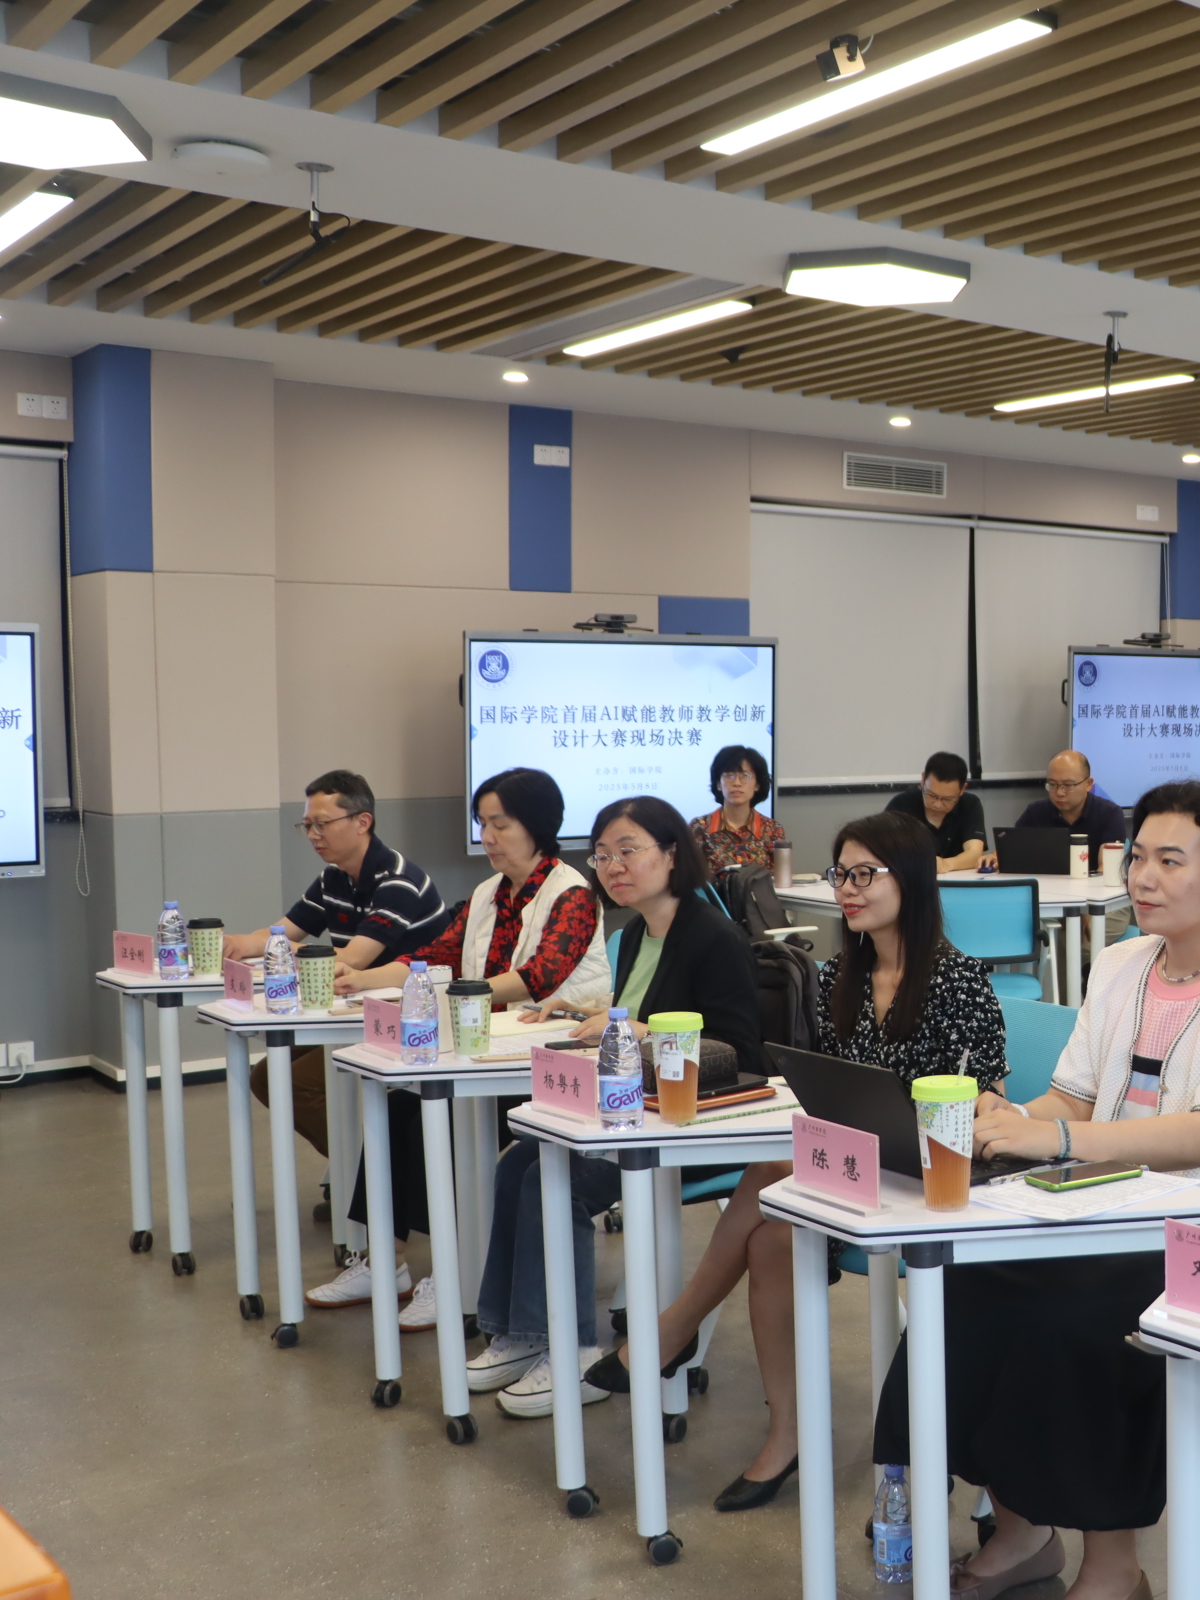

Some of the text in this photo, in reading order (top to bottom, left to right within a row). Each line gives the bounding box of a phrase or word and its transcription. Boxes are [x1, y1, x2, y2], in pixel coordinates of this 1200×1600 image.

[480, 704, 766, 724] 国际学院首届AI赋能教师教学创新
[552, 728, 702, 748] 设计大赛现场决赛
[543, 1070, 581, 1098] 杨粤青
[812, 1148, 861, 1182] 陈慧
